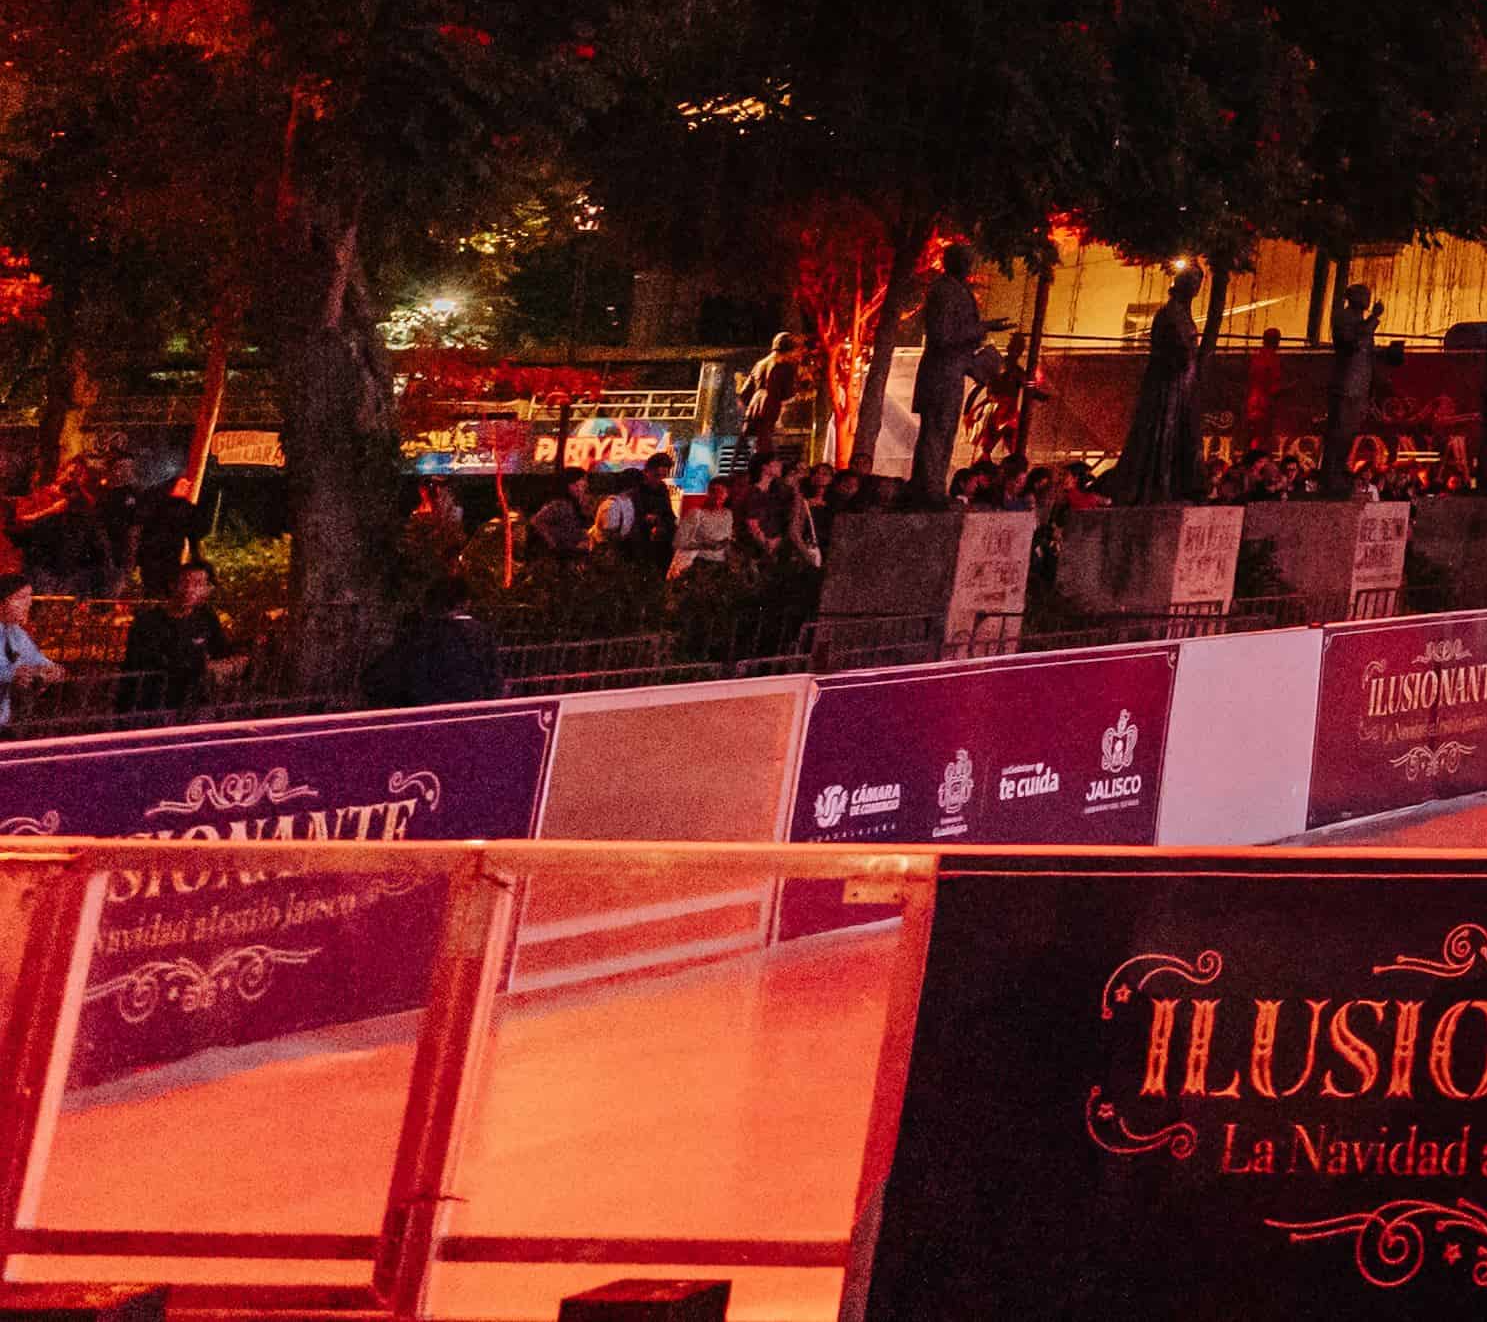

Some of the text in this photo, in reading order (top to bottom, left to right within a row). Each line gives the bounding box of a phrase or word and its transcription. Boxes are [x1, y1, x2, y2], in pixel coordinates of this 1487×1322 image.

[851, 783, 900, 804] CÁMARA
[999, 777, 1016, 800] te
[1017, 766, 1060, 797] cuida
[1085, 774, 1141, 801] JALISCO
[1221, 1124, 1275, 1174] La
[1288, 1124, 1471, 1176] Navidad
